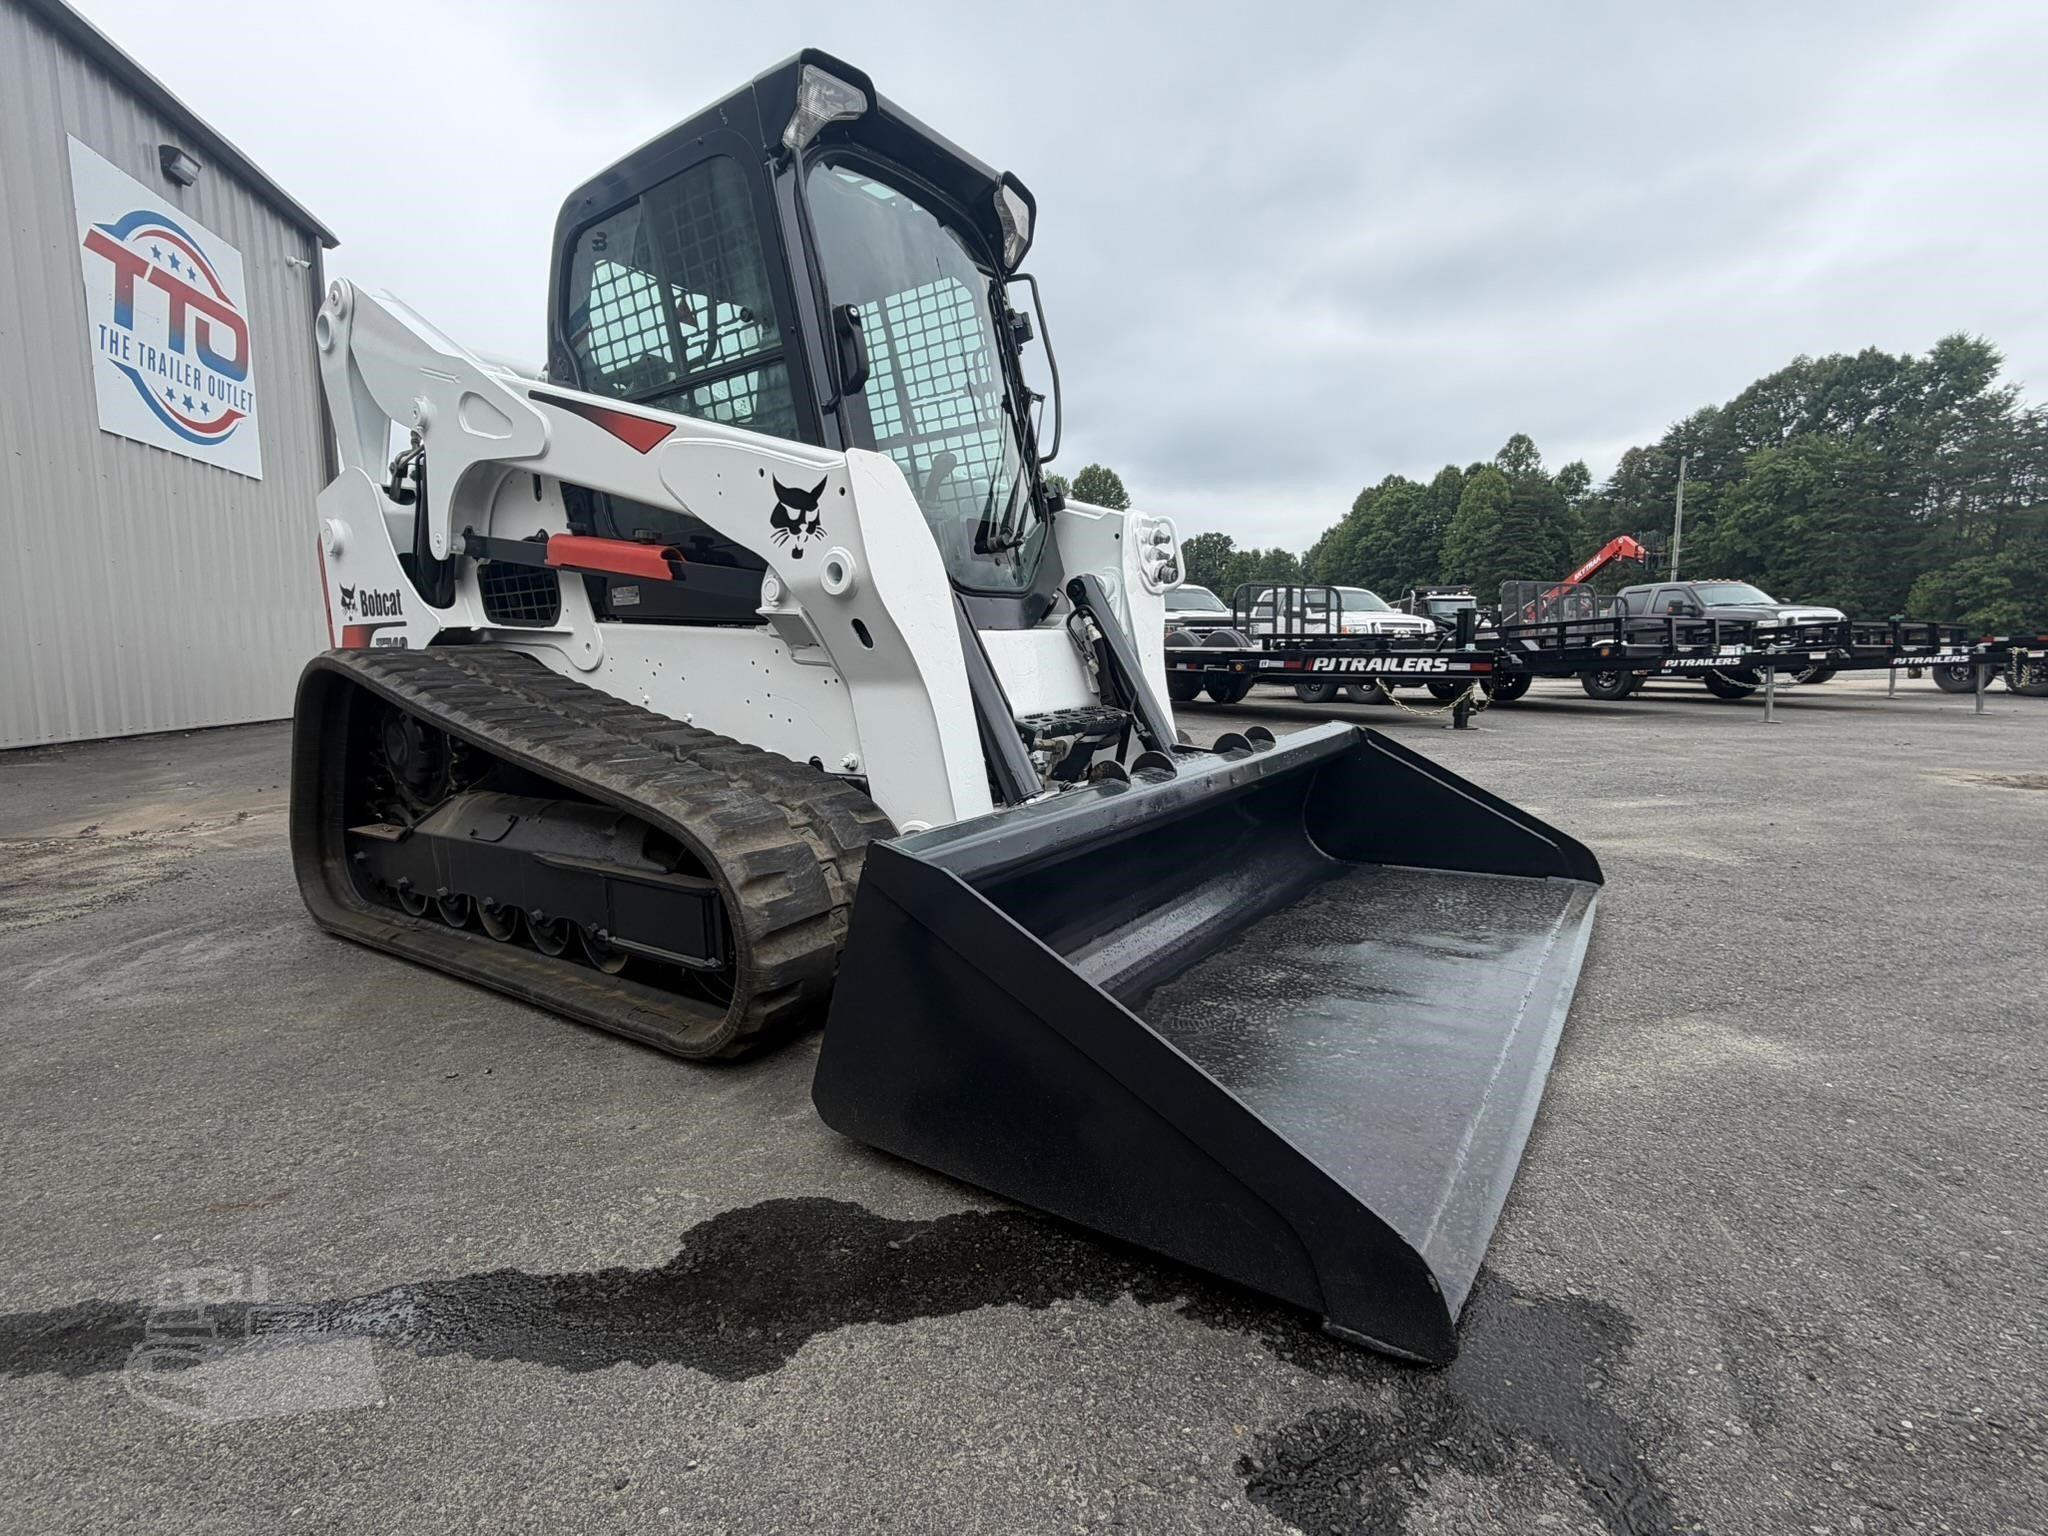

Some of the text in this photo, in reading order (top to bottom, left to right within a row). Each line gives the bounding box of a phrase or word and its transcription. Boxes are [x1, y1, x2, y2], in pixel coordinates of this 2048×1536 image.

[83, 228, 248, 383] TTO
[99, 324, 254, 413] THE TRAILER OUTLET
[360, 589, 403, 617] Bobcat
